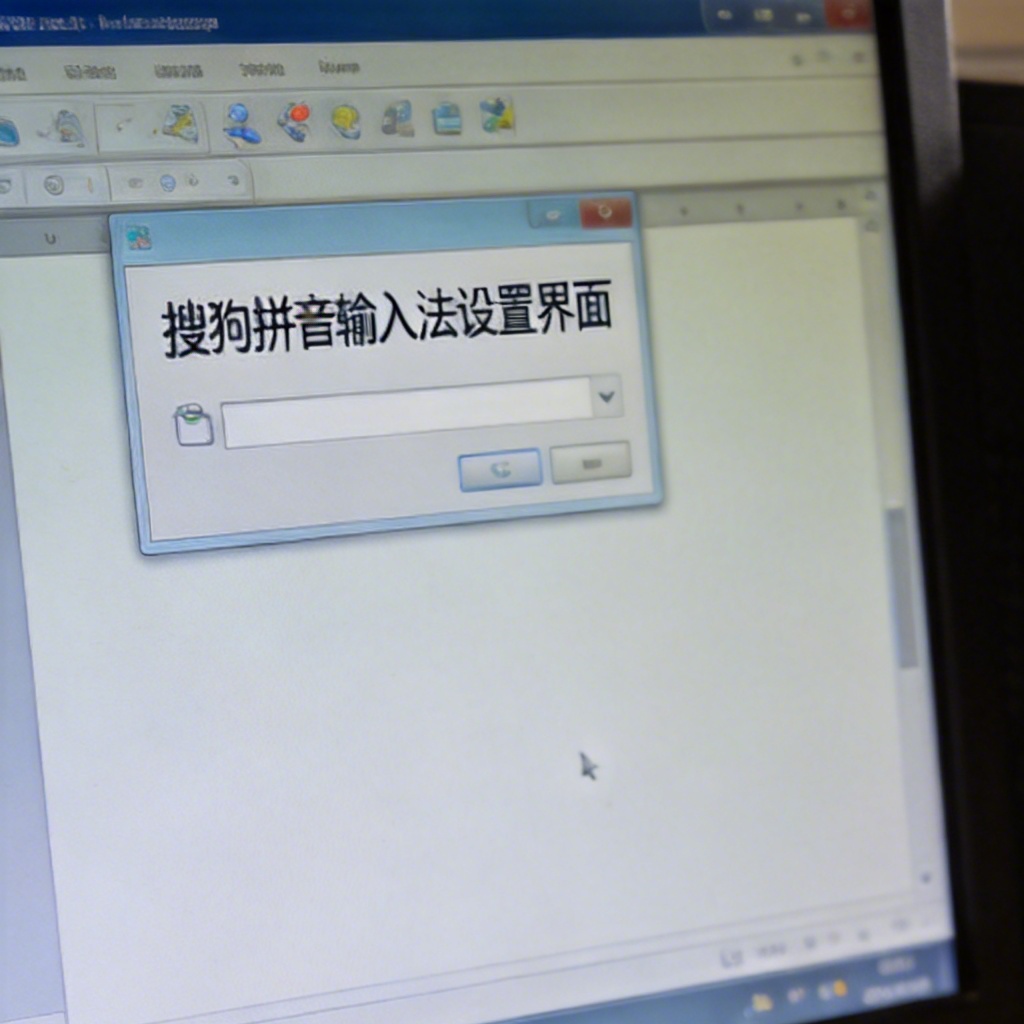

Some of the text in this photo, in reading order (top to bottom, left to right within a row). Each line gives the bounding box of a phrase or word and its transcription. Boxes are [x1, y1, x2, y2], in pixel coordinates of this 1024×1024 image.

[161, 279, 612, 359] 搜狗拼音输入法设置界面
